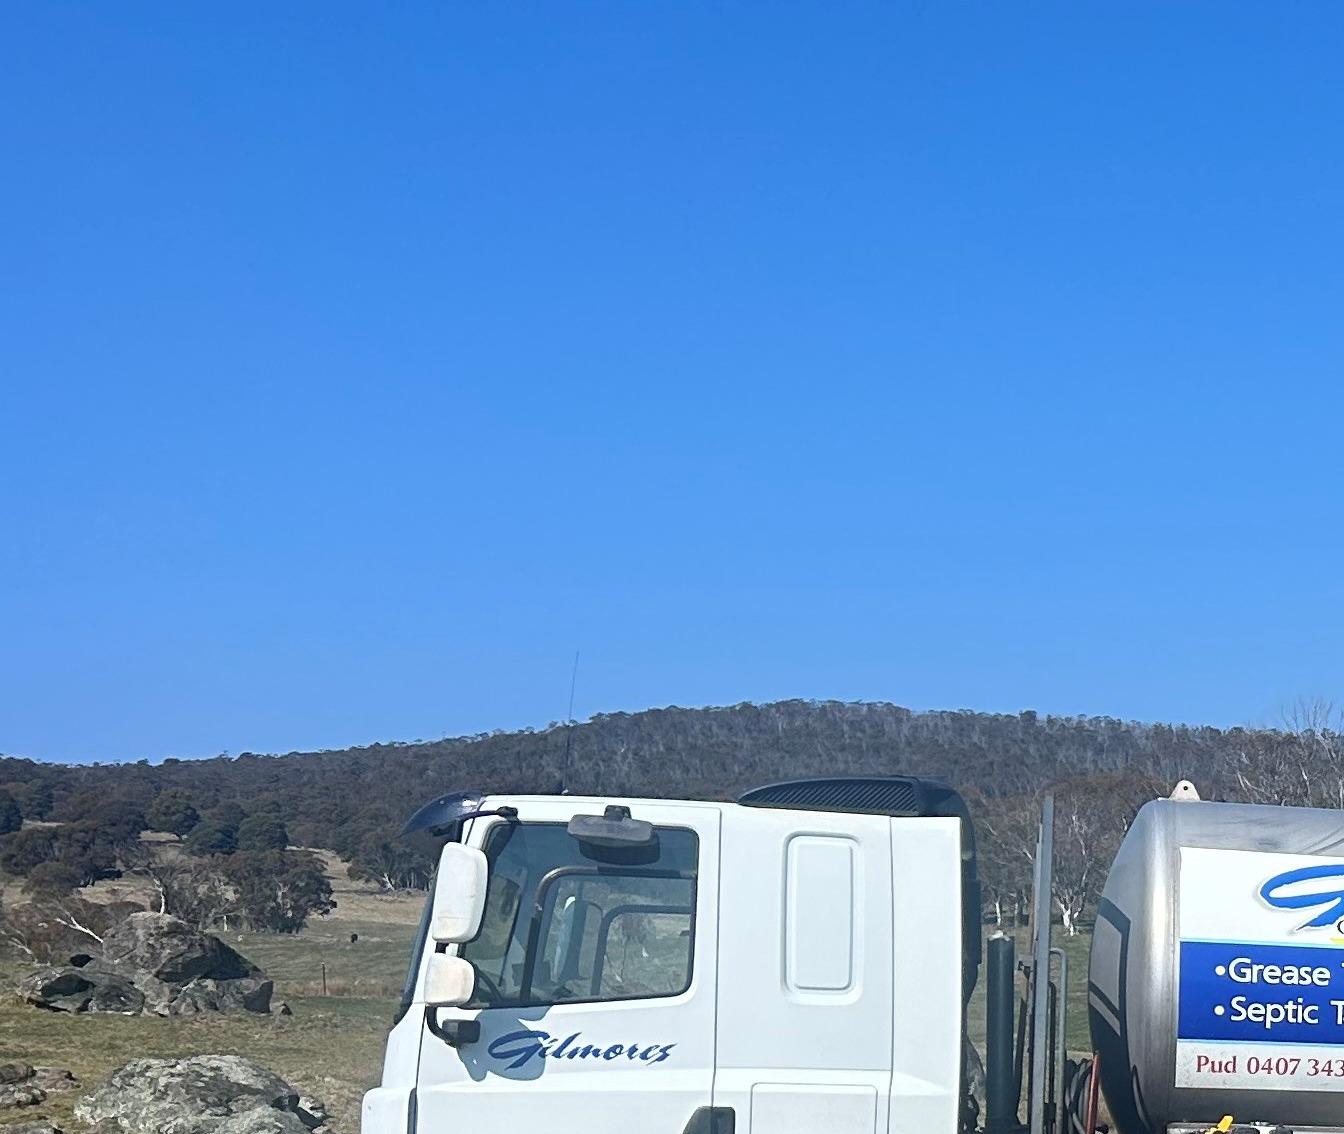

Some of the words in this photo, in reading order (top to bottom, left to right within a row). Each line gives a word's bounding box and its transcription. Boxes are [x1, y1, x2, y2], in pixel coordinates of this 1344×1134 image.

[1228, 957, 1331, 986] Grease
[1230, 996, 1319, 1029] Septic
[487, 1030, 677, 1070] Gilmores
[1196, 1055, 1237, 1074] Pud
[1246, 1057, 1301, 1075] 0407
